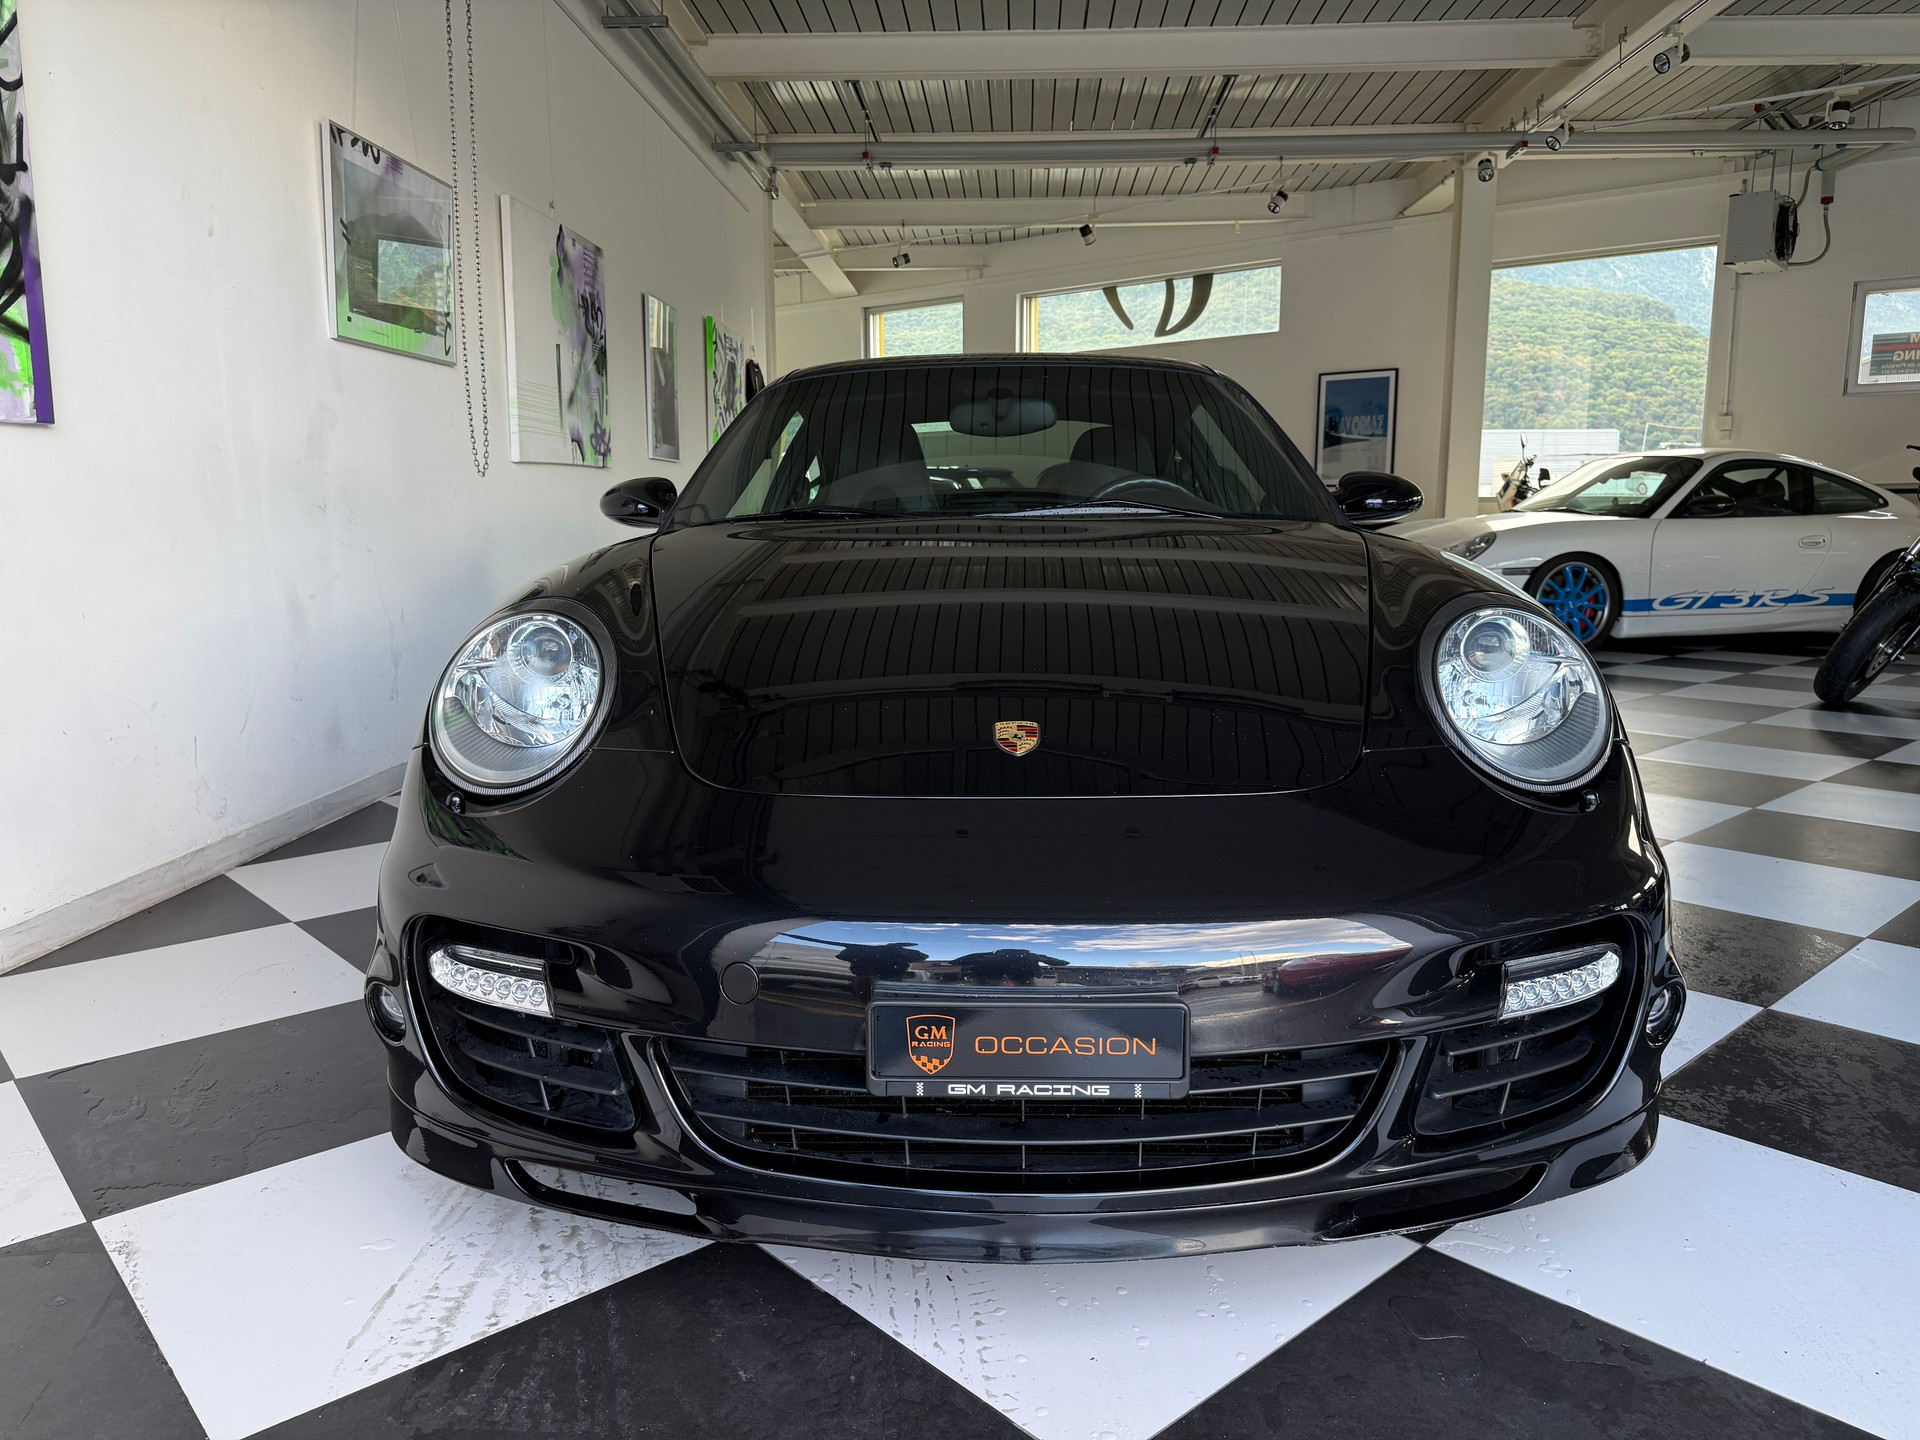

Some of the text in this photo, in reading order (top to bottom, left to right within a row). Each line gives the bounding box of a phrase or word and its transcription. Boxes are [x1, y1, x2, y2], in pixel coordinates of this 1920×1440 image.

[914, 1025, 948, 1040] GM
[974, 1036, 1157, 1056] OCCASION
[947, 1083, 1111, 1096] GM RACING
